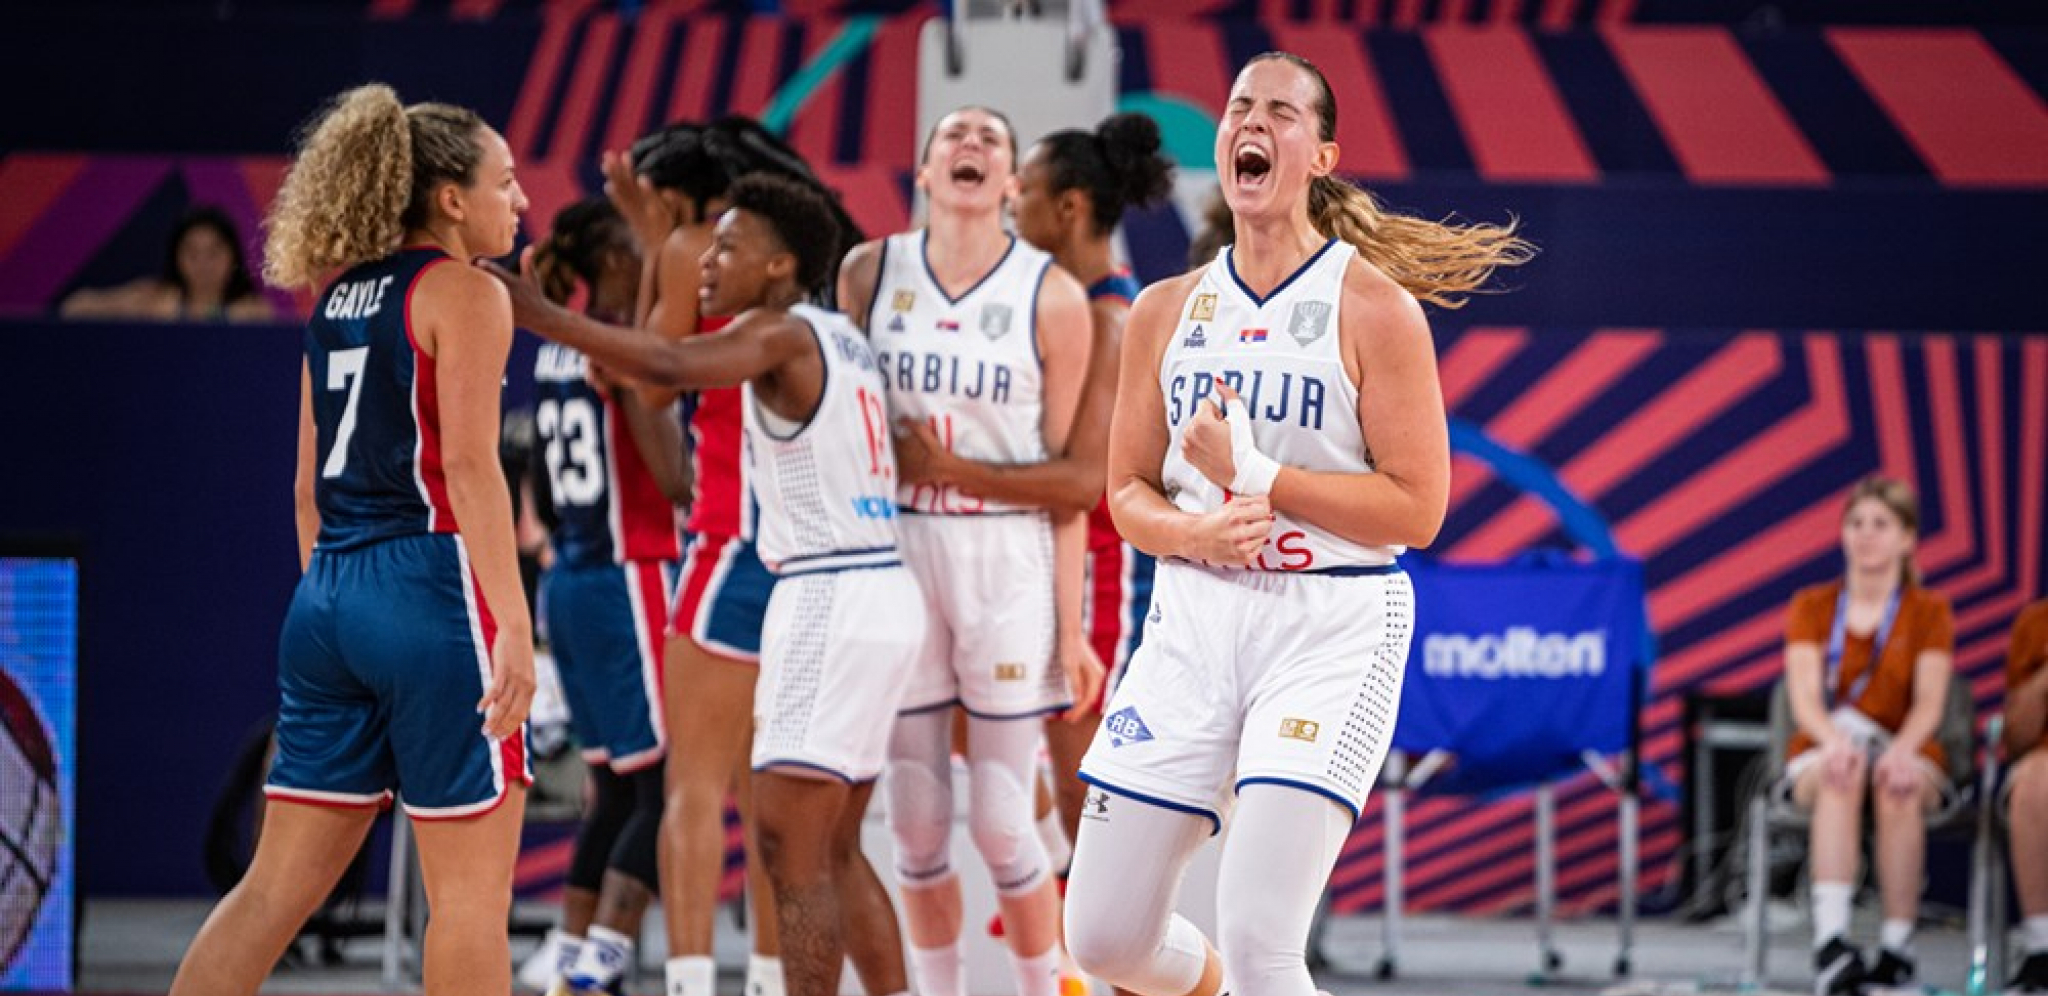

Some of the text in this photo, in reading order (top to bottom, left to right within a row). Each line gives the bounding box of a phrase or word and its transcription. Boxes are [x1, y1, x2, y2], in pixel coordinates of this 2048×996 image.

[324, 274, 393, 319] GAYLE
[877, 351, 1011, 404] SRBIJA
[321, 345, 370, 480] 7
[536, 397, 604, 505] 23
[1423, 626, 1606, 679] molten
